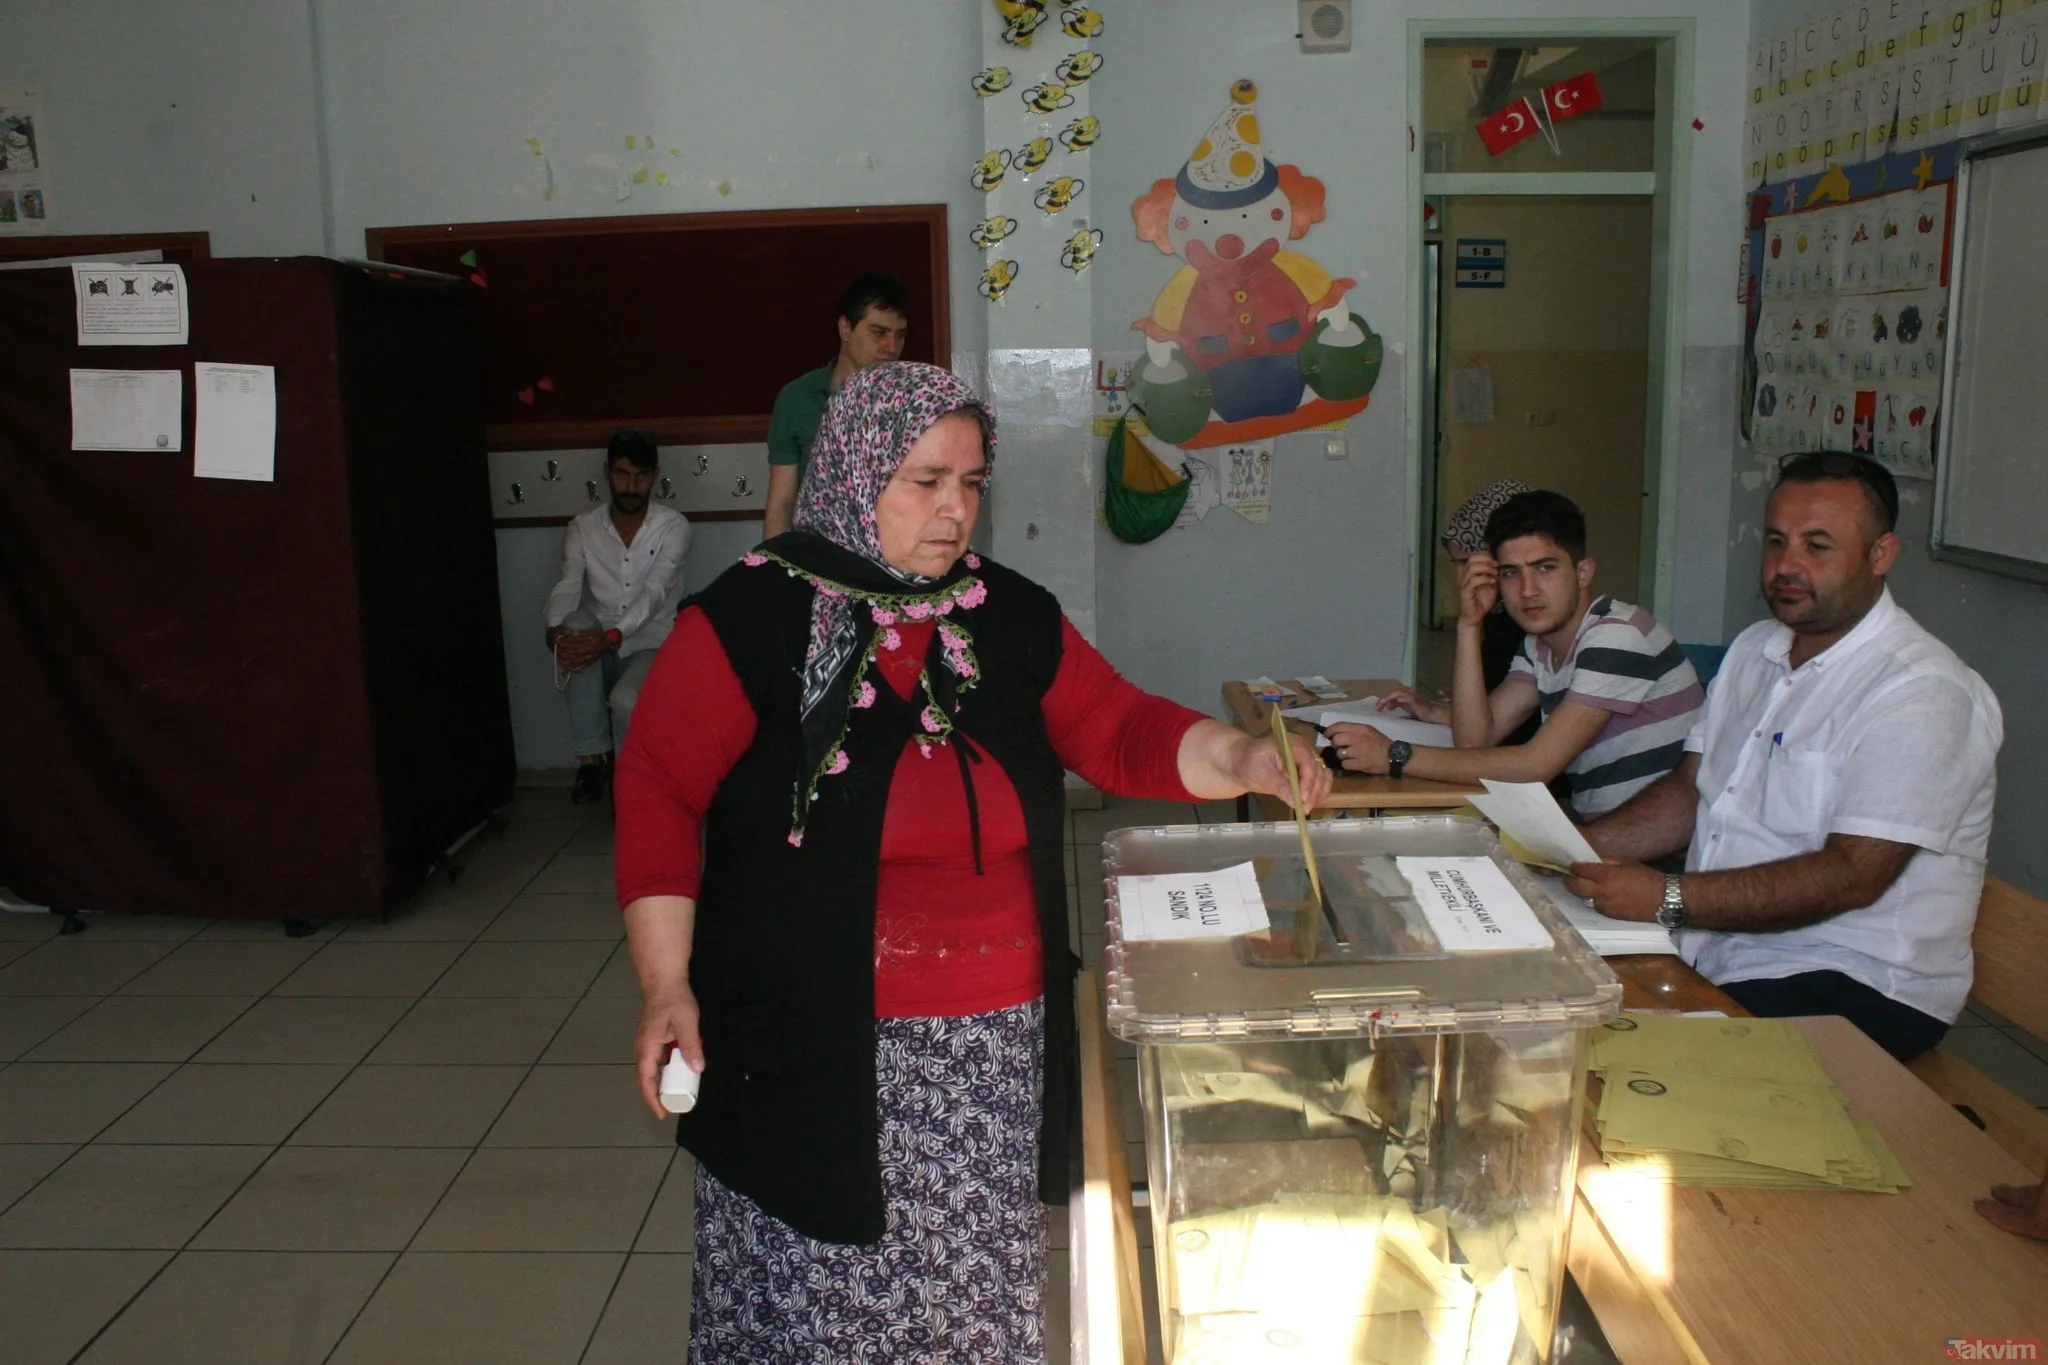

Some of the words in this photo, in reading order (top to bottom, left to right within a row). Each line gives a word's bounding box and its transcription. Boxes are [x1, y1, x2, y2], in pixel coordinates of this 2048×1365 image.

[1756, 50, 1763, 70] A
[1780, 41, 1787, 62] B
[1805, 29, 1815, 52] C
[1859, 8, 1869, 32] D
[1754, 86, 1762, 104] a
[1779, 68, 1787, 96] b
[1804, 69, 1812, 87] c
[1857, 34, 1866, 68] d
[1886, 38, 1895, 58] e
[1919, 10, 1930, 47] f
[1952, 11, 1965, 48] g
[1752, 124, 1762, 146] N
[1776, 114, 1786, 136] O
[1825, 99, 1832, 122] P
[1854, 90, 1862, 114] R
[1881, 80, 1890, 105] S
[1947, 57, 1959, 85] T
[1981, 45, 1996, 74] U
[2021, 31, 2038, 68] Ü
[1752, 160, 1760, 178] n
[1776, 152, 1783, 169] o
[1800, 140, 1808, 164] ö
[1824, 139, 1834, 169] p
[1851, 132, 1860, 149] r
[1878, 124, 1886, 143] s
[1944, 98, 1952, 126] t
[1977, 95, 1990, 116] u
[2016, 76, 2032, 107] ü
[1471, 247, 1492, 257] 1-B
[1909, 250, 1920, 272] N
[1927, 262, 1935, 274] n
[1471, 271, 1491, 281] 5-F
[1167, 890, 1191, 921] SANDIK
[1482, 924, 1502, 934] VE
